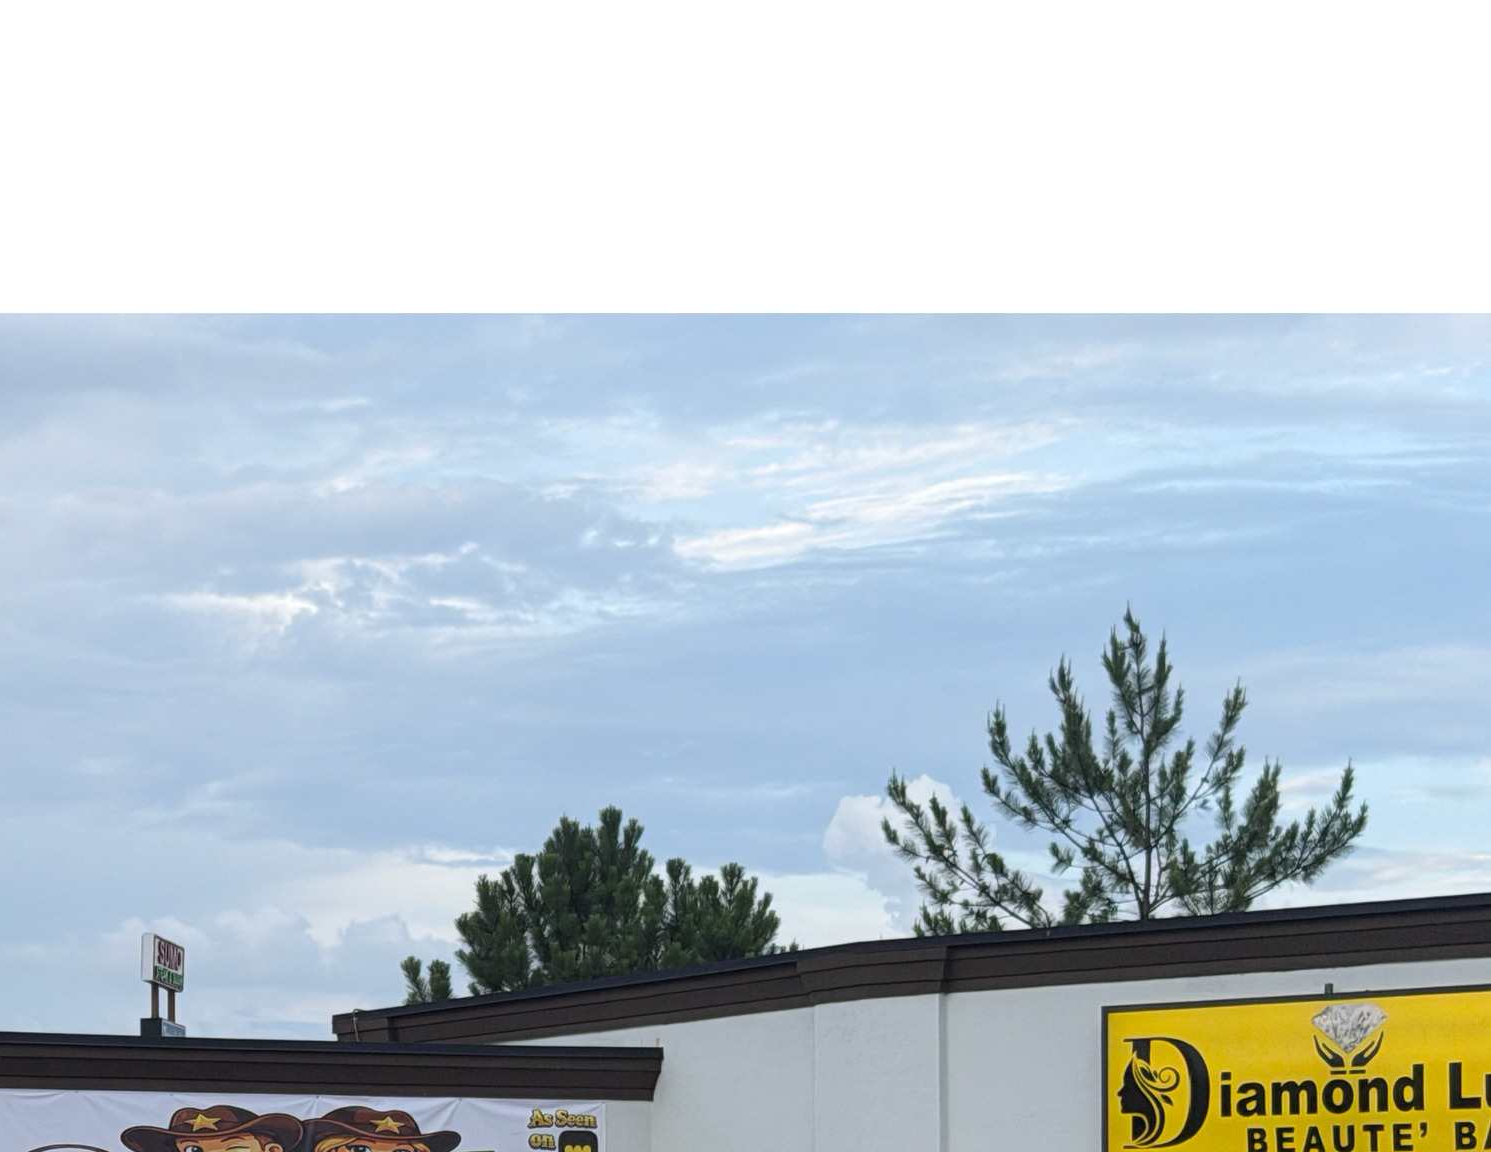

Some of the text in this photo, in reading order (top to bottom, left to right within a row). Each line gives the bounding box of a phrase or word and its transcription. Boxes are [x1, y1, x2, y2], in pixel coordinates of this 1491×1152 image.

[1117, 1037, 1425, 1149] Diamond
[528, 1109, 597, 1129] As Seen
[528, 1133, 556, 1151] on
